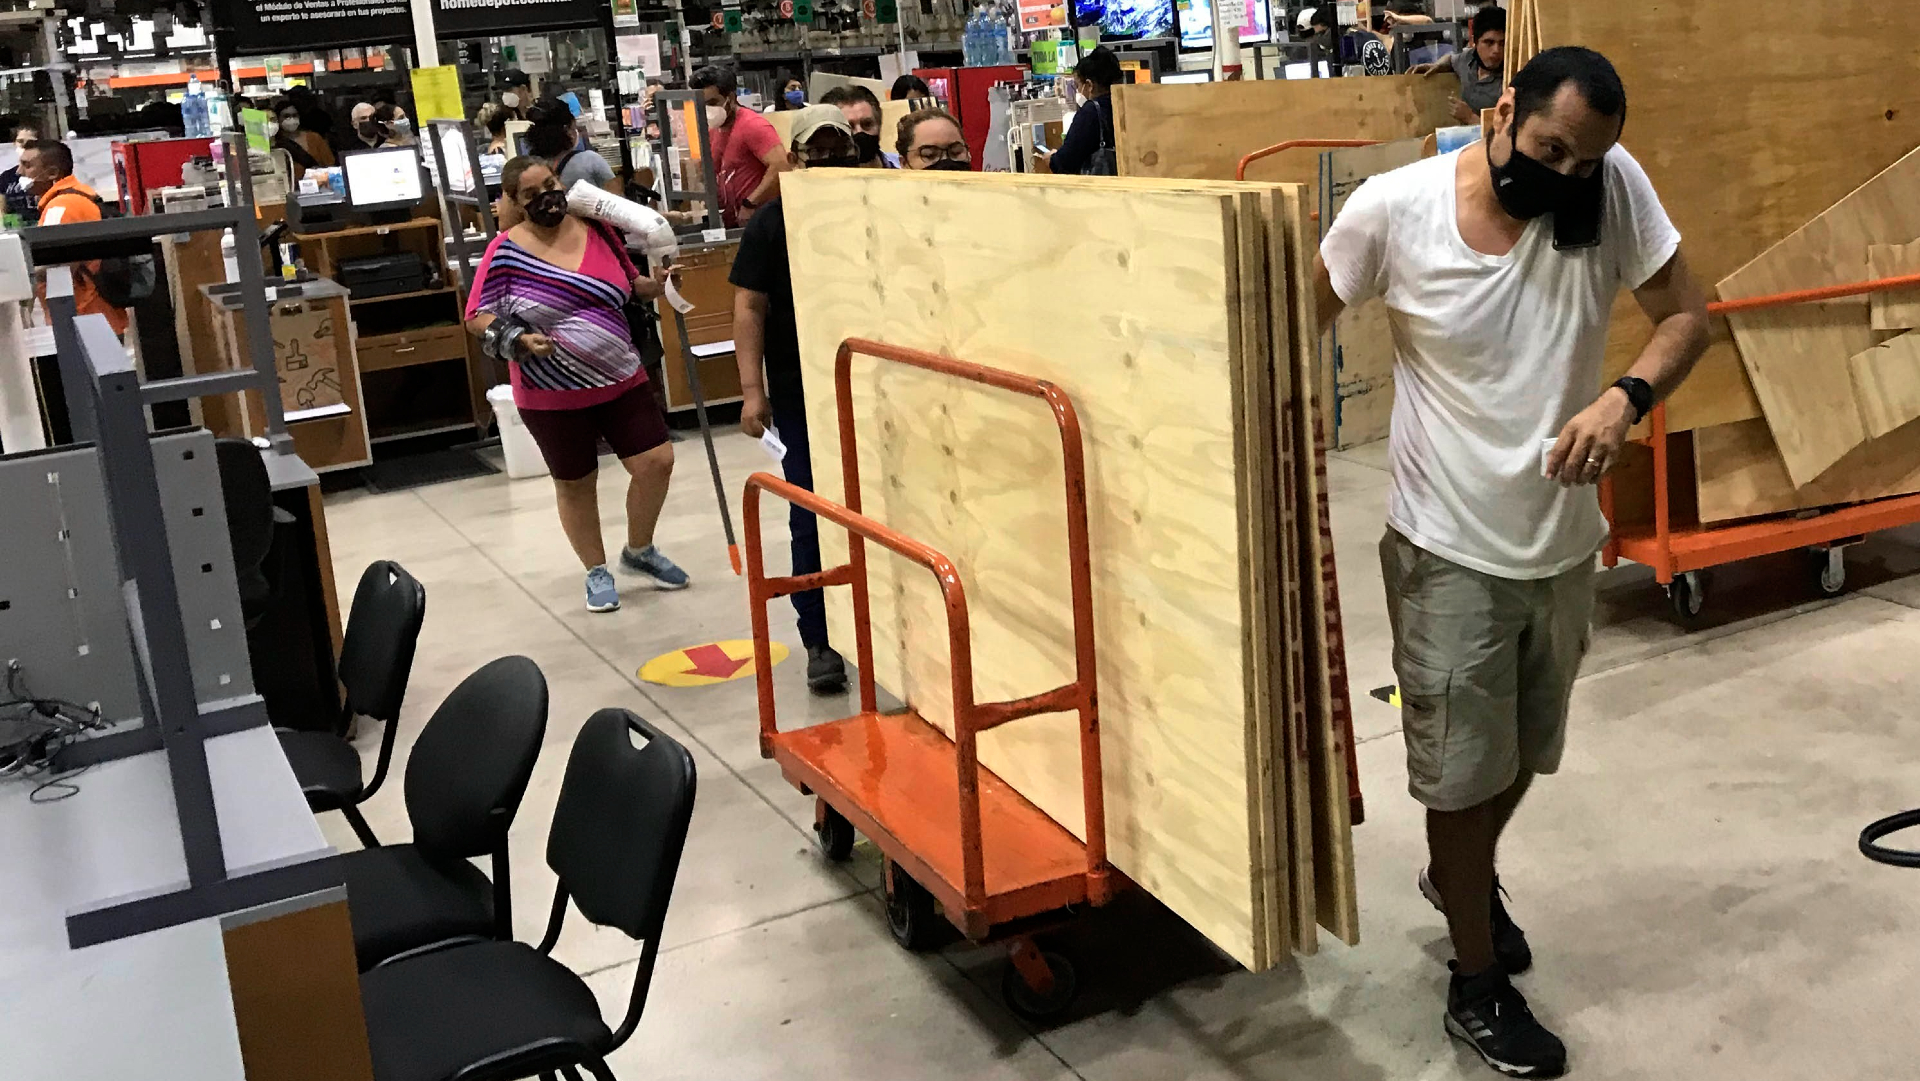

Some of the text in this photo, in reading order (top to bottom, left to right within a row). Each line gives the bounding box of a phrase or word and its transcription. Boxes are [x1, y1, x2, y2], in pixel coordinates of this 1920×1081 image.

[264, 2, 292, 11] Módulo
[293, 1, 303, 9] de
[303, 1, 329, 9] Ventas
[260, 15, 271, 23] un
[271, 13, 300, 22] experto
[301, 12, 309, 20] te
[357, 8, 370, 16] tus
[370, 6, 407, 17] proyectos.
